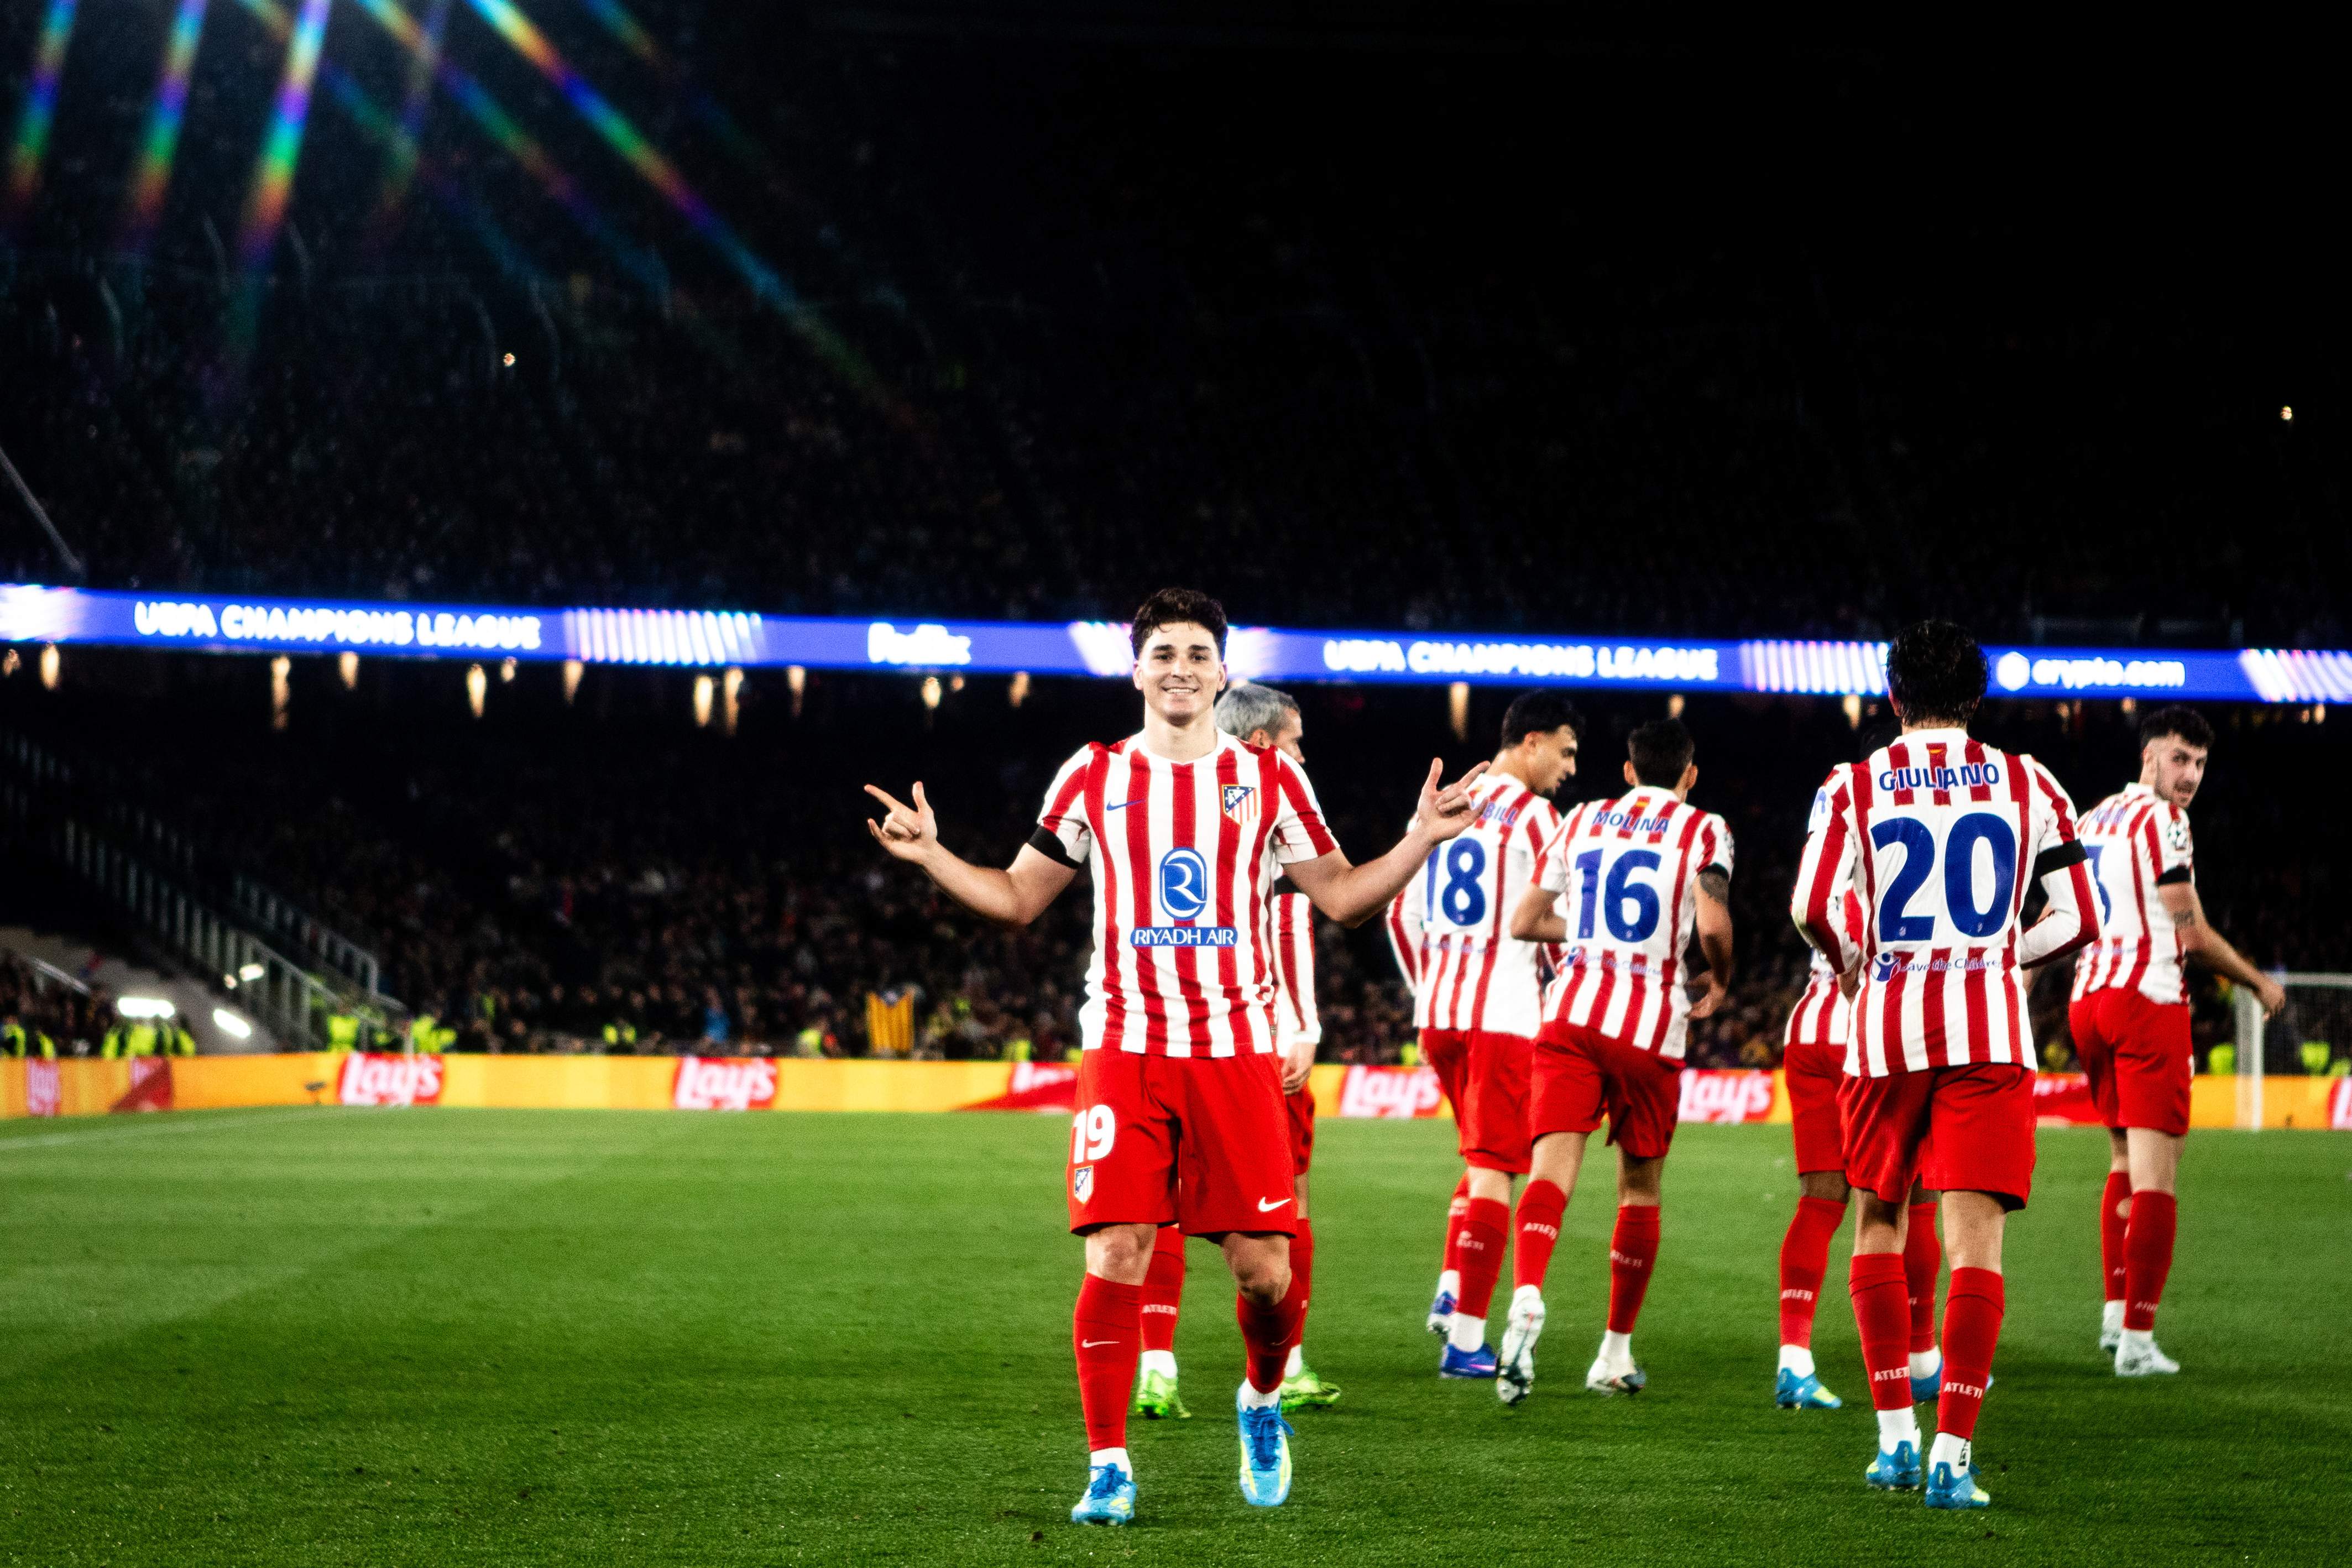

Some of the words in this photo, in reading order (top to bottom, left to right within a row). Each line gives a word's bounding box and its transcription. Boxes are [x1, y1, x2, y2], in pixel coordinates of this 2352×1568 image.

[134, 601, 218, 637] UEFA
[220, 604, 414, 646] CHAMPIONS
[416, 612, 541, 650] LEAGUE
[1407, 641, 1595, 678] CHAMPIONS
[1597, 646, 1718, 681] LEAGUE
[1879, 763, 2000, 792] GIULIANO
[1592, 811, 1670, 833] MOLINA
[1575, 848, 1661, 943] 16
[1870, 813, 2016, 942] 20
[1135, 929, 1201, 944] RIYADH
[1206, 929, 1234, 944] AIR
[1073, 1105, 1115, 1164] 19
[1943, 1382, 1983, 1399] ATLETI
